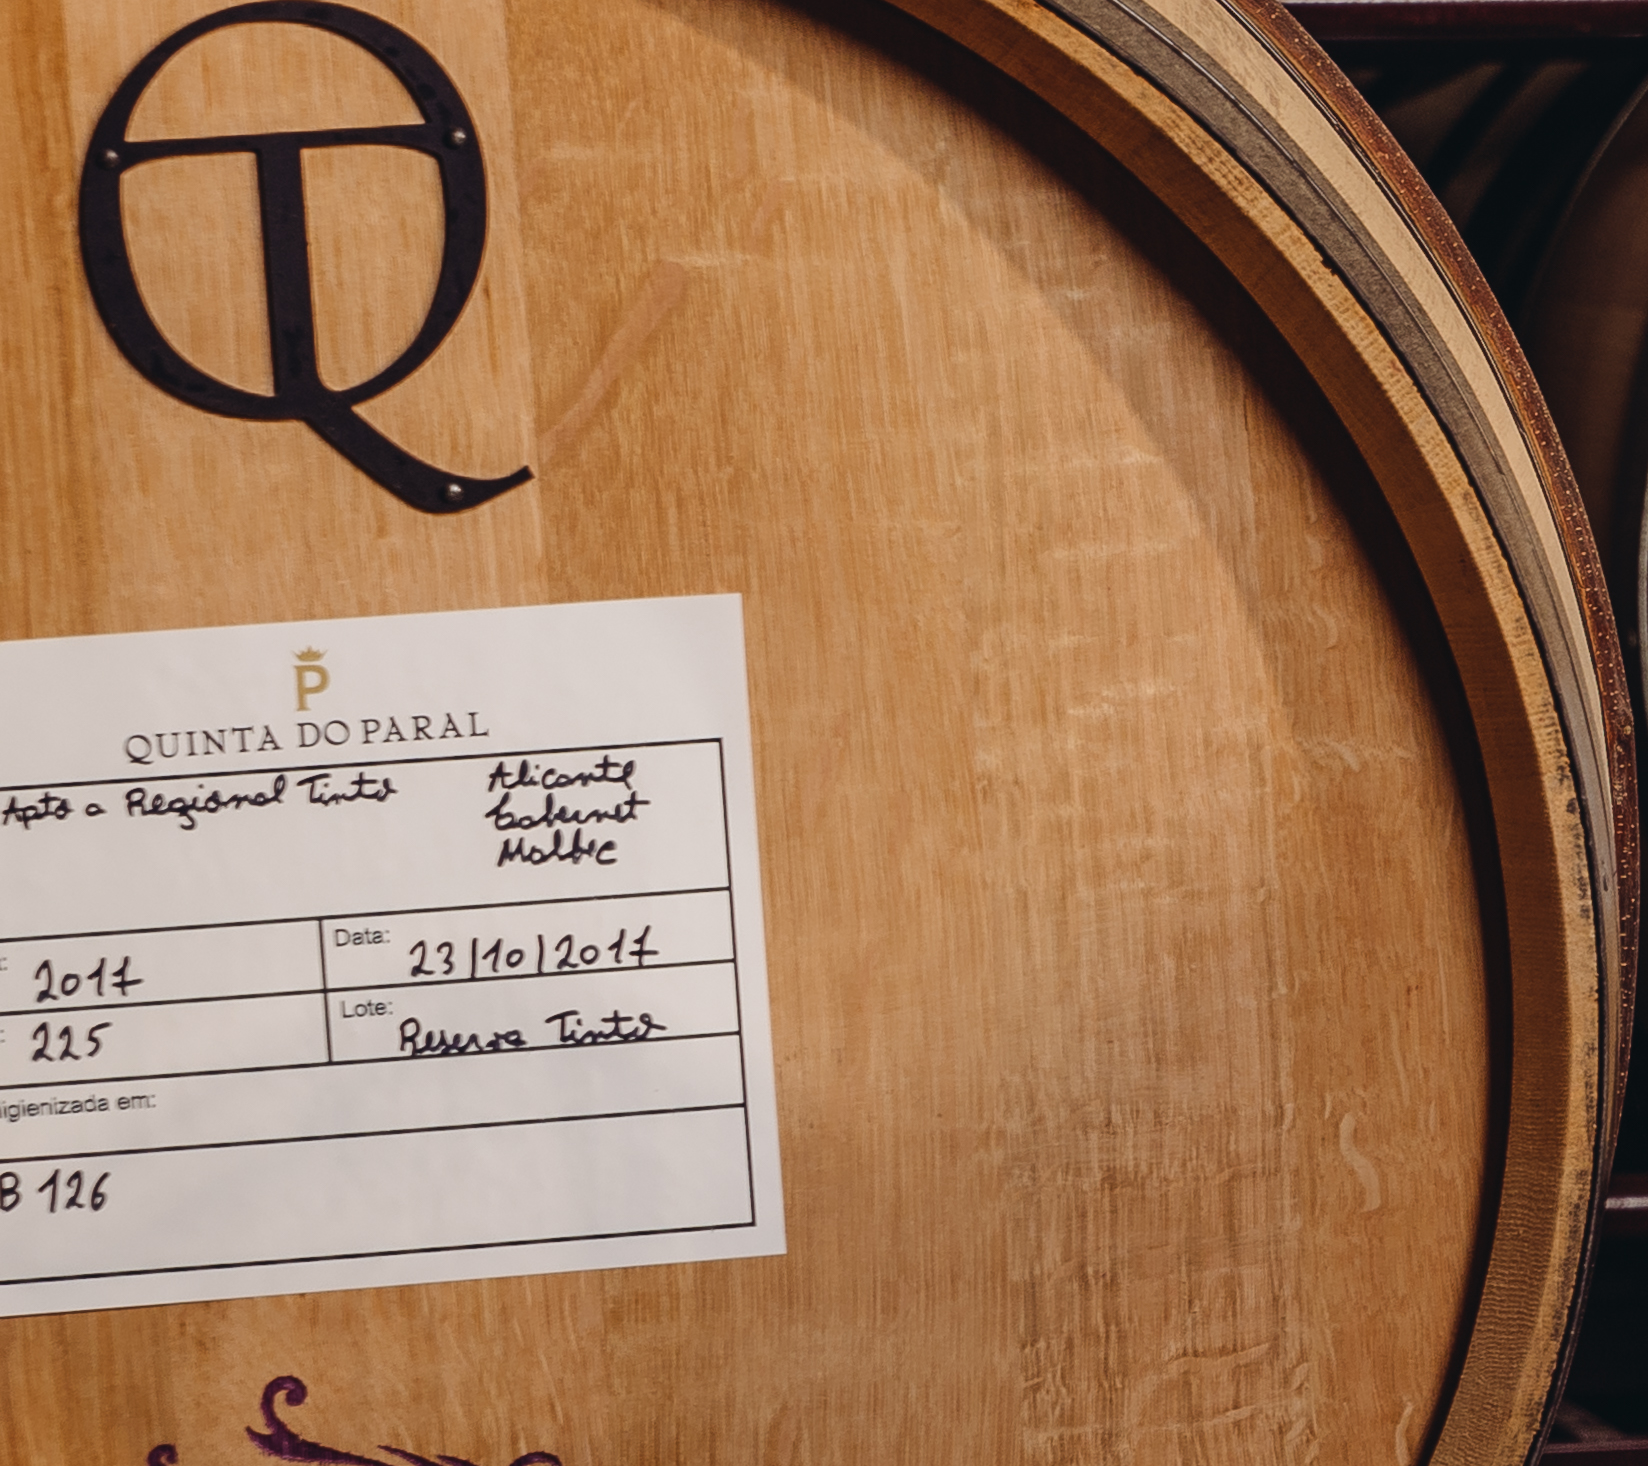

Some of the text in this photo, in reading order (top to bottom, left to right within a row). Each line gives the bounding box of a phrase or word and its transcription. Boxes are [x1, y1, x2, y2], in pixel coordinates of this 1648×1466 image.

[125, 712, 490, 765] QUINTA DO PARAL
[487, 755, 638, 793] Alicante
[3, 771, 400, 830] Apto a Regional Tinto
[485, 790, 652, 832] Cabernet
[334, 926, 391, 947] Data:
[409, 924, 661, 980] 23/10/2017
[34, 955, 146, 1003] 2017
[341, 999, 393, 1019] Lote:
[31, 1021, 114, 1063] 225
[399, 1009, 668, 1060] Reserva Tinto
[117, 1094, 156, 1111] em:
[38, 1168, 112, 1214] 126
